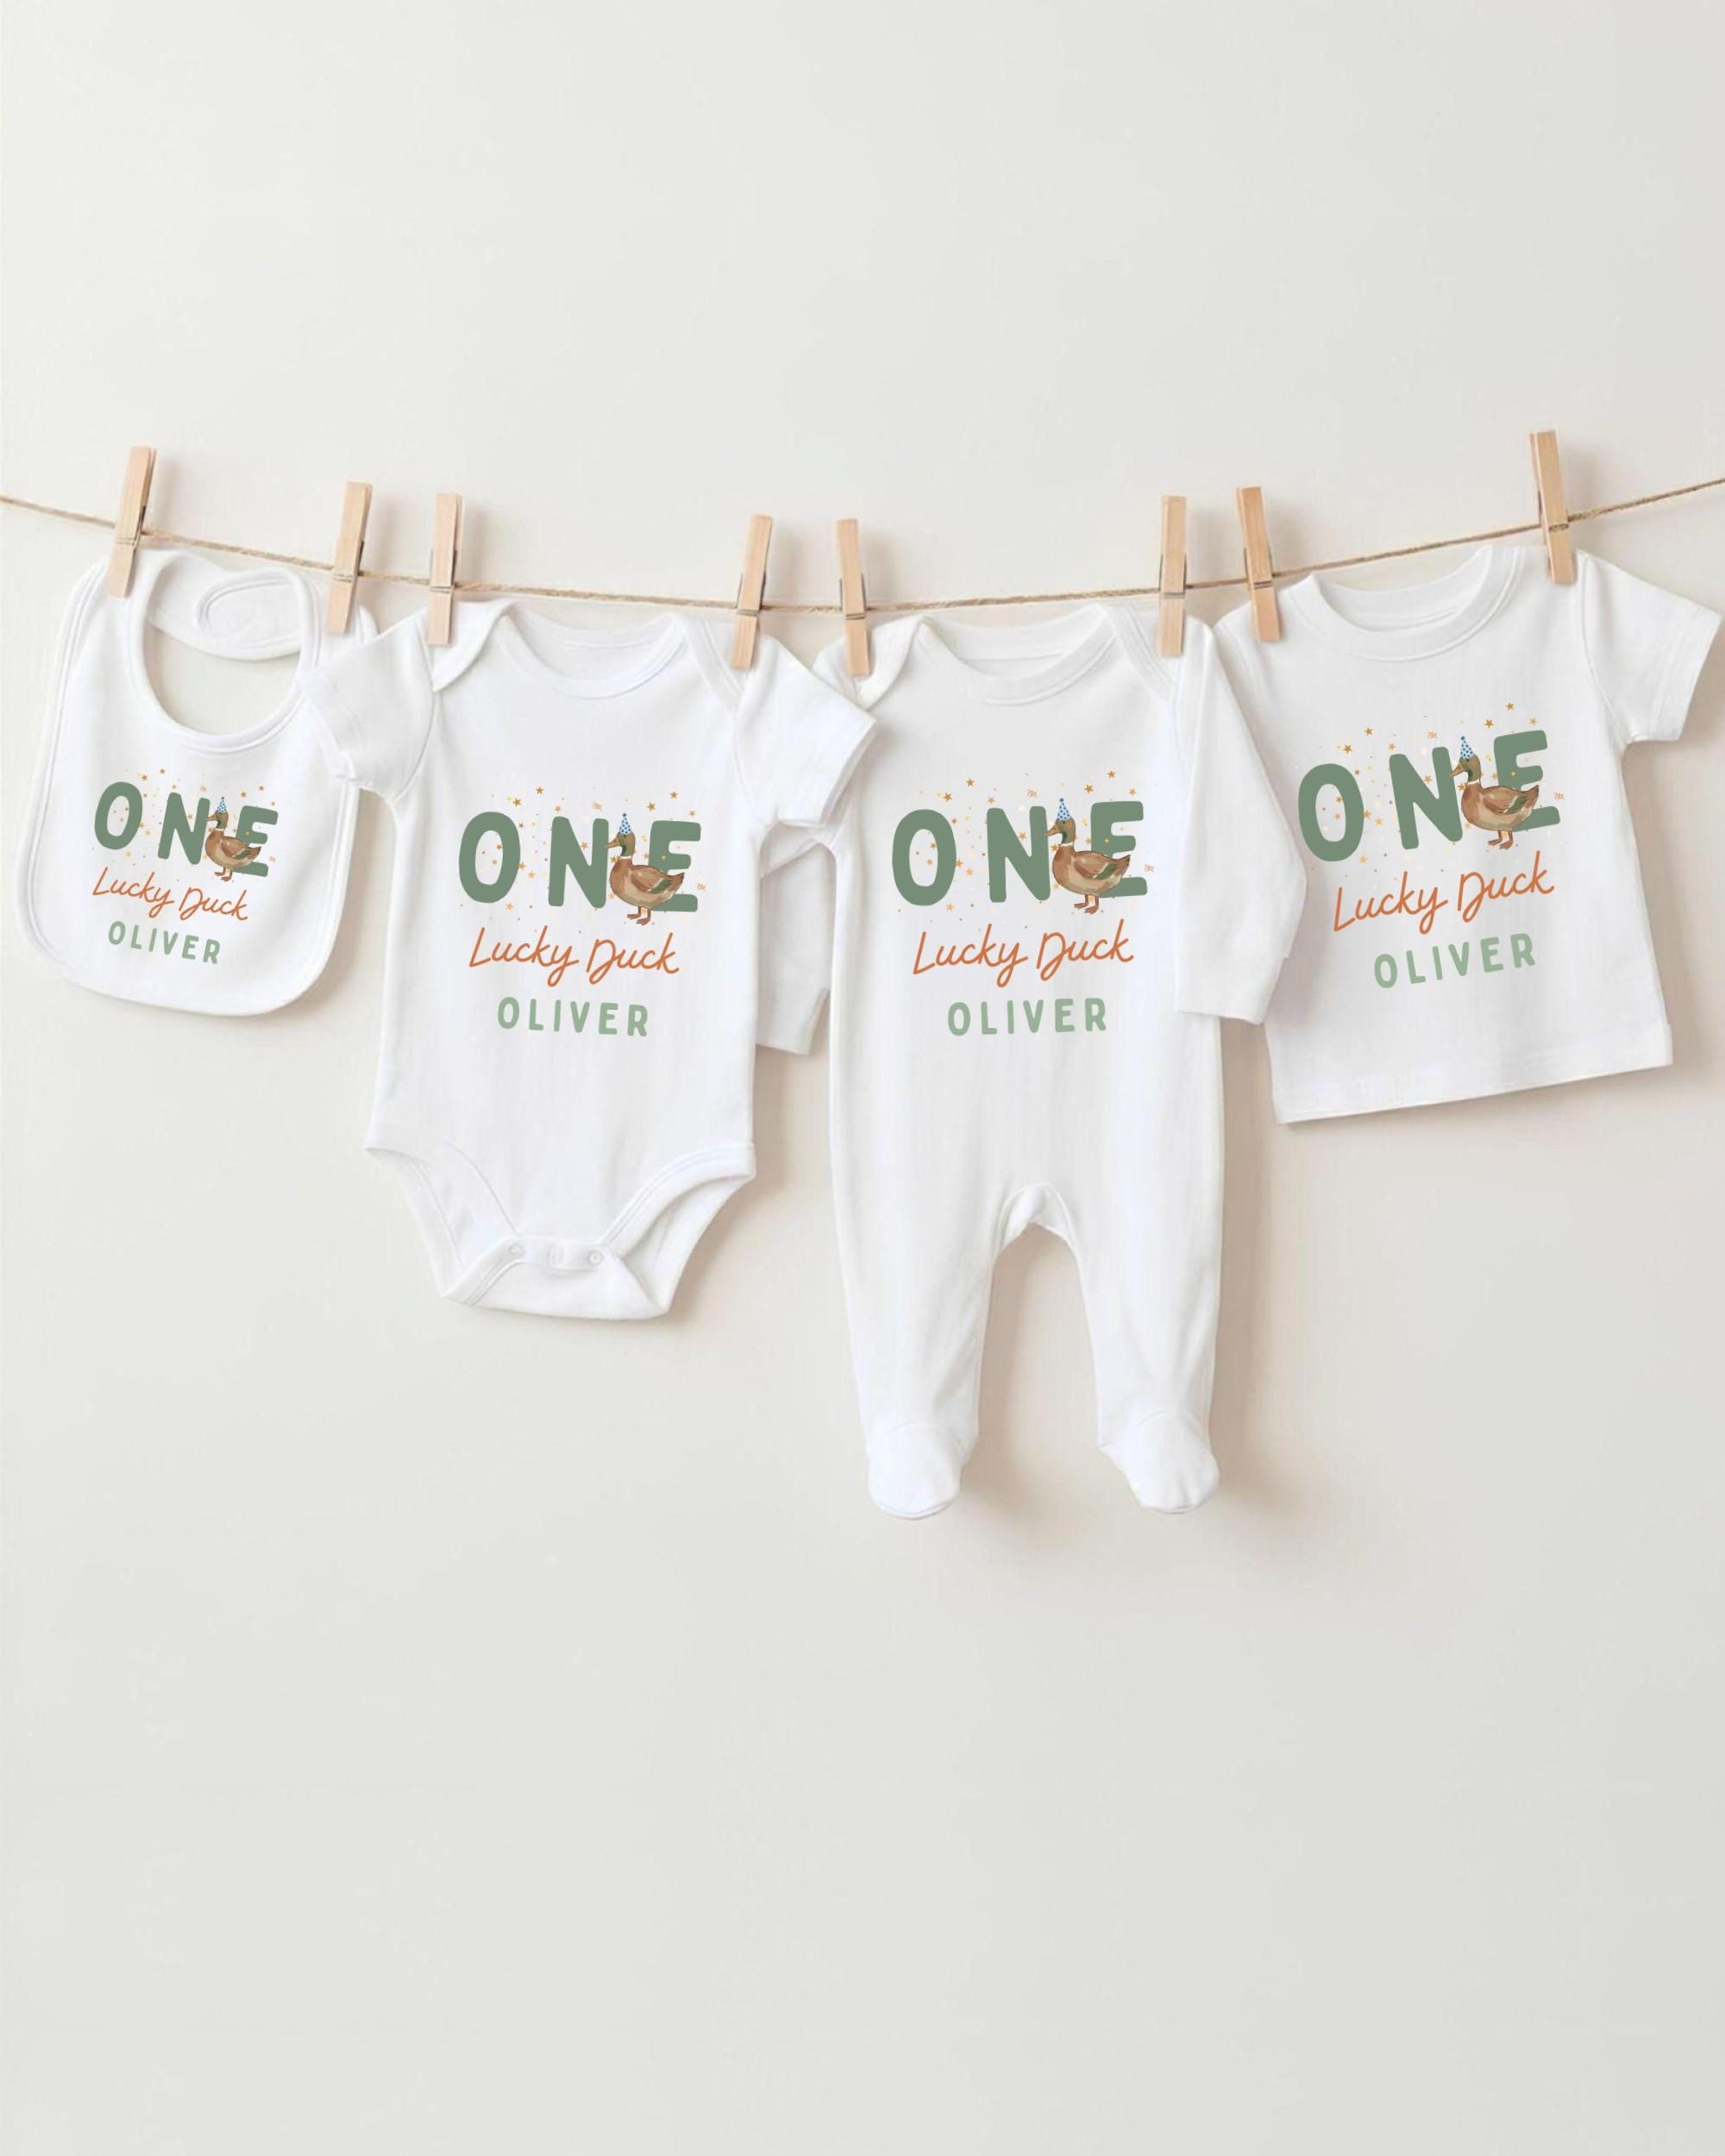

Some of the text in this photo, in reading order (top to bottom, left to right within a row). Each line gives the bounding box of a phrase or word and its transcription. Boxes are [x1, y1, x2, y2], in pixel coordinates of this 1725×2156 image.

[1298, 730, 1560, 862] ONE
[94, 781, 279, 877] ONE
[459, 811, 701, 912] ONE
[892, 800, 1148, 906] ONE
[92, 867, 248, 921] Lucky Duck
[1333, 850, 1555, 935] Lucky Duck
[108, 920, 221, 964] OLIVER
[469, 925, 680, 987] Lucky Duck
[913, 918, 1134, 987] Lucky Duck
[1374, 933, 1536, 989] OLIVER
[497, 996, 648, 1037] OLIVER
[947, 997, 1107, 1037] OLIVER
